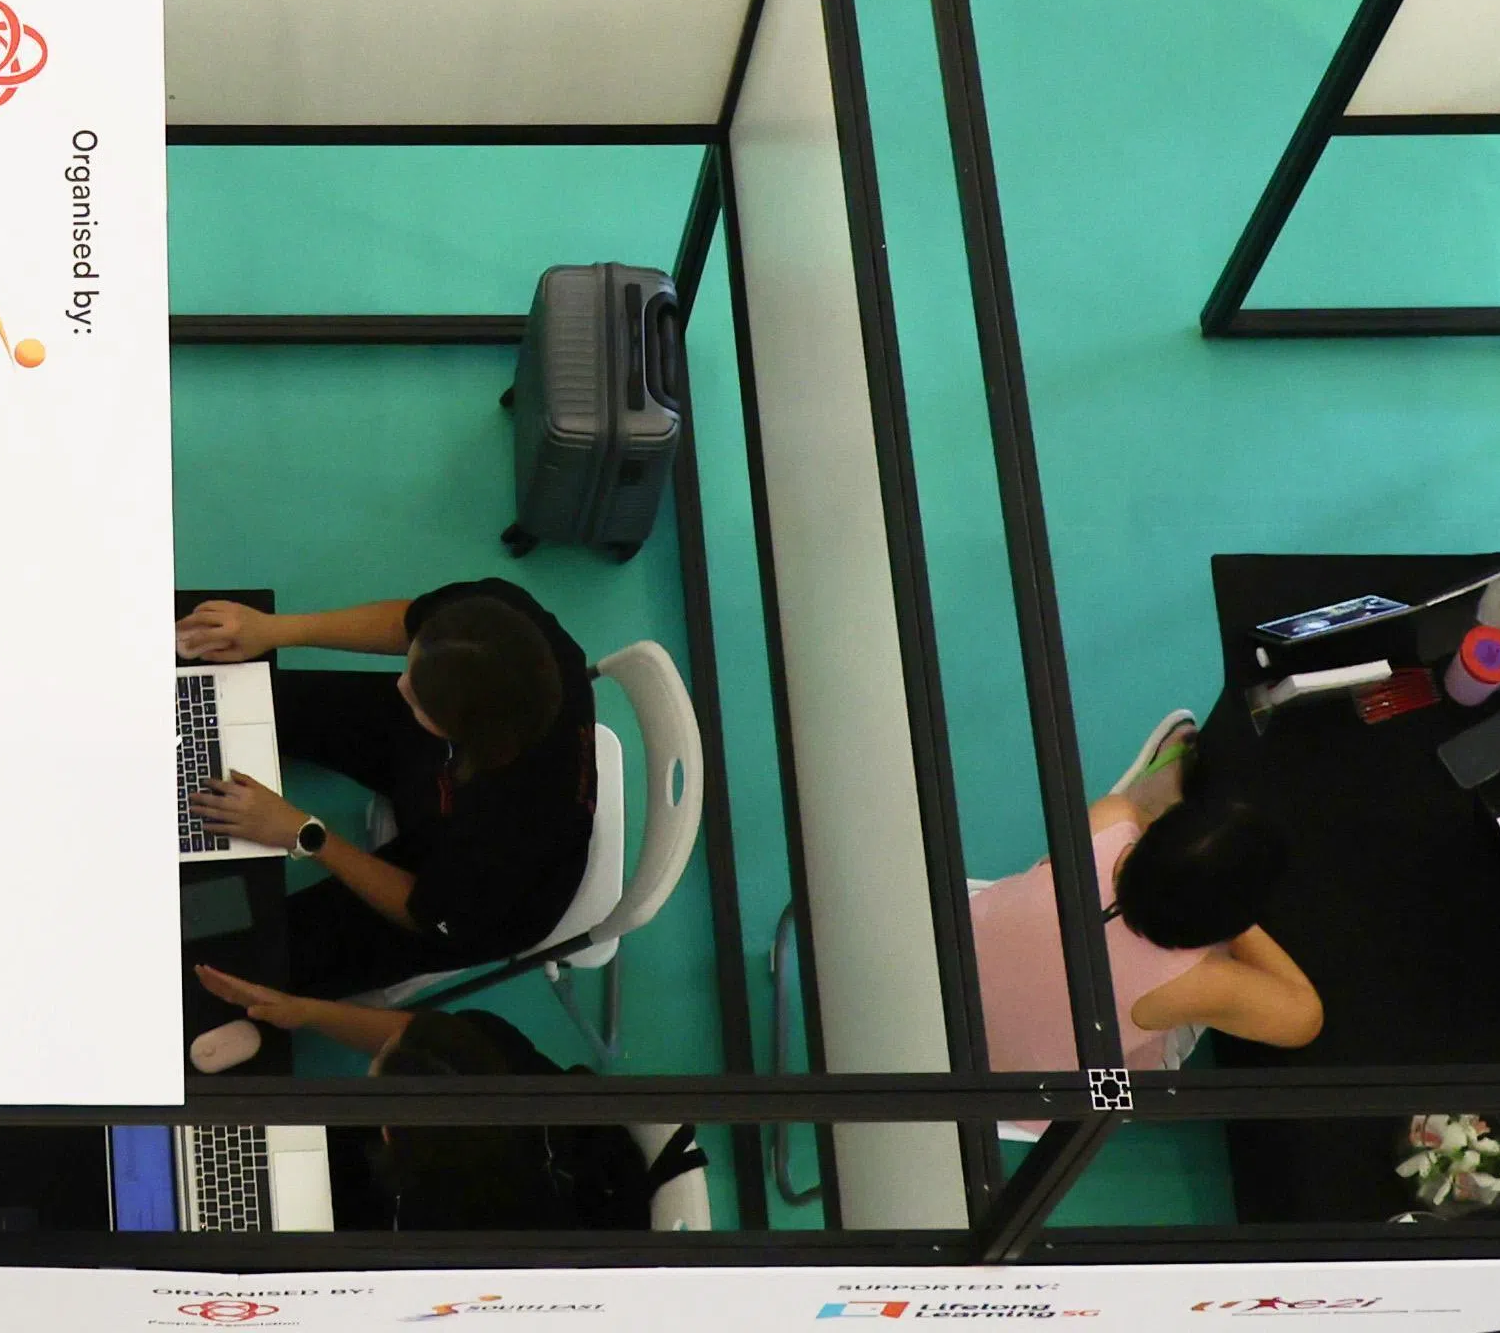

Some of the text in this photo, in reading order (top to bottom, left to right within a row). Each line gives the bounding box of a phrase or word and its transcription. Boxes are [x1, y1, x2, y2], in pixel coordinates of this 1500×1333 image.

[65, 130, 99, 335] Organised by:
[1016, 1283, 1060, 1291] BY:
[152, 1288, 374, 1297] ORGANISED BY:
[916, 1302, 1052, 1311] Lifelong
[1294, 1297, 1384, 1309] e2i
[914, 1309, 1100, 1320] Learning SG
